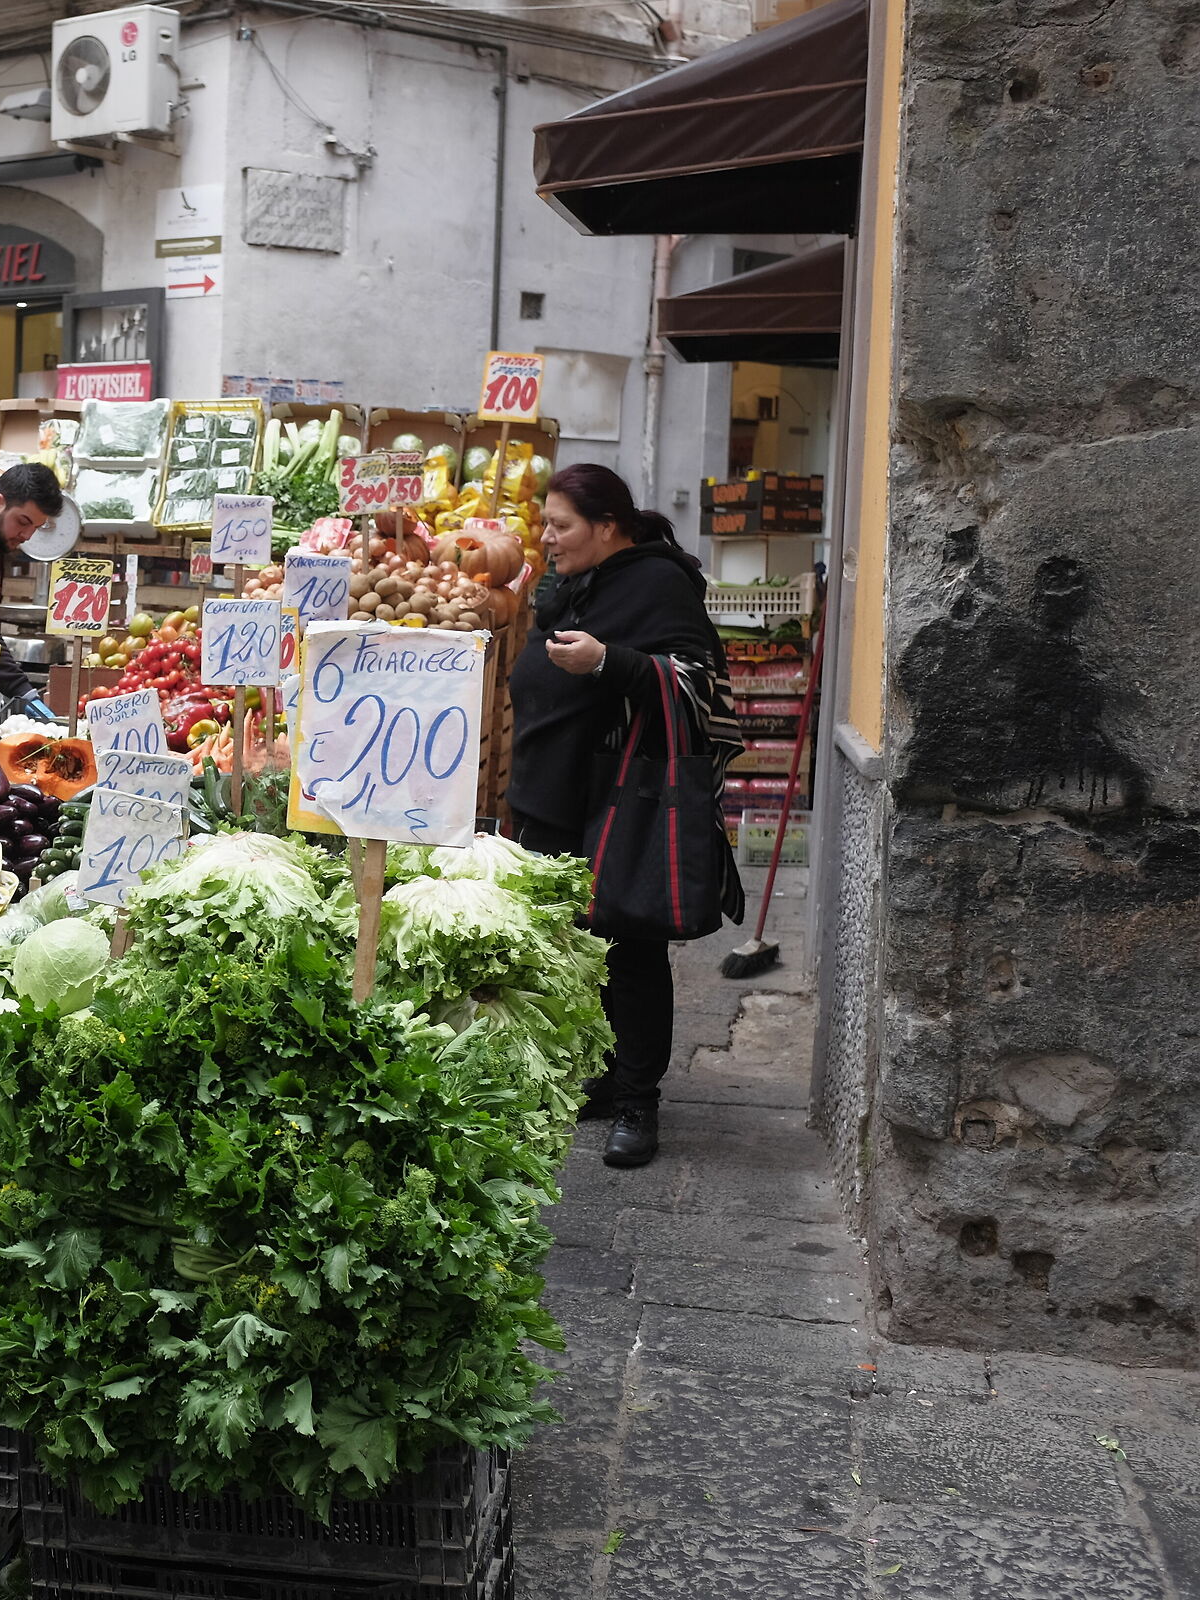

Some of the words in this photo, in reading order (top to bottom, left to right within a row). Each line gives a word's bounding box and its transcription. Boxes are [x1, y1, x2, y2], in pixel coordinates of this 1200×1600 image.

[121, 50, 137, 62] LG
[65, 373, 145, 399] L'OFFISIEL
[341, 458, 356, 488] 3
[215, 519, 267, 553] 150
[209, 621, 276, 678] 120
[313, 637, 348, 703] 6
[121, 757, 188, 776] LATTUGA
